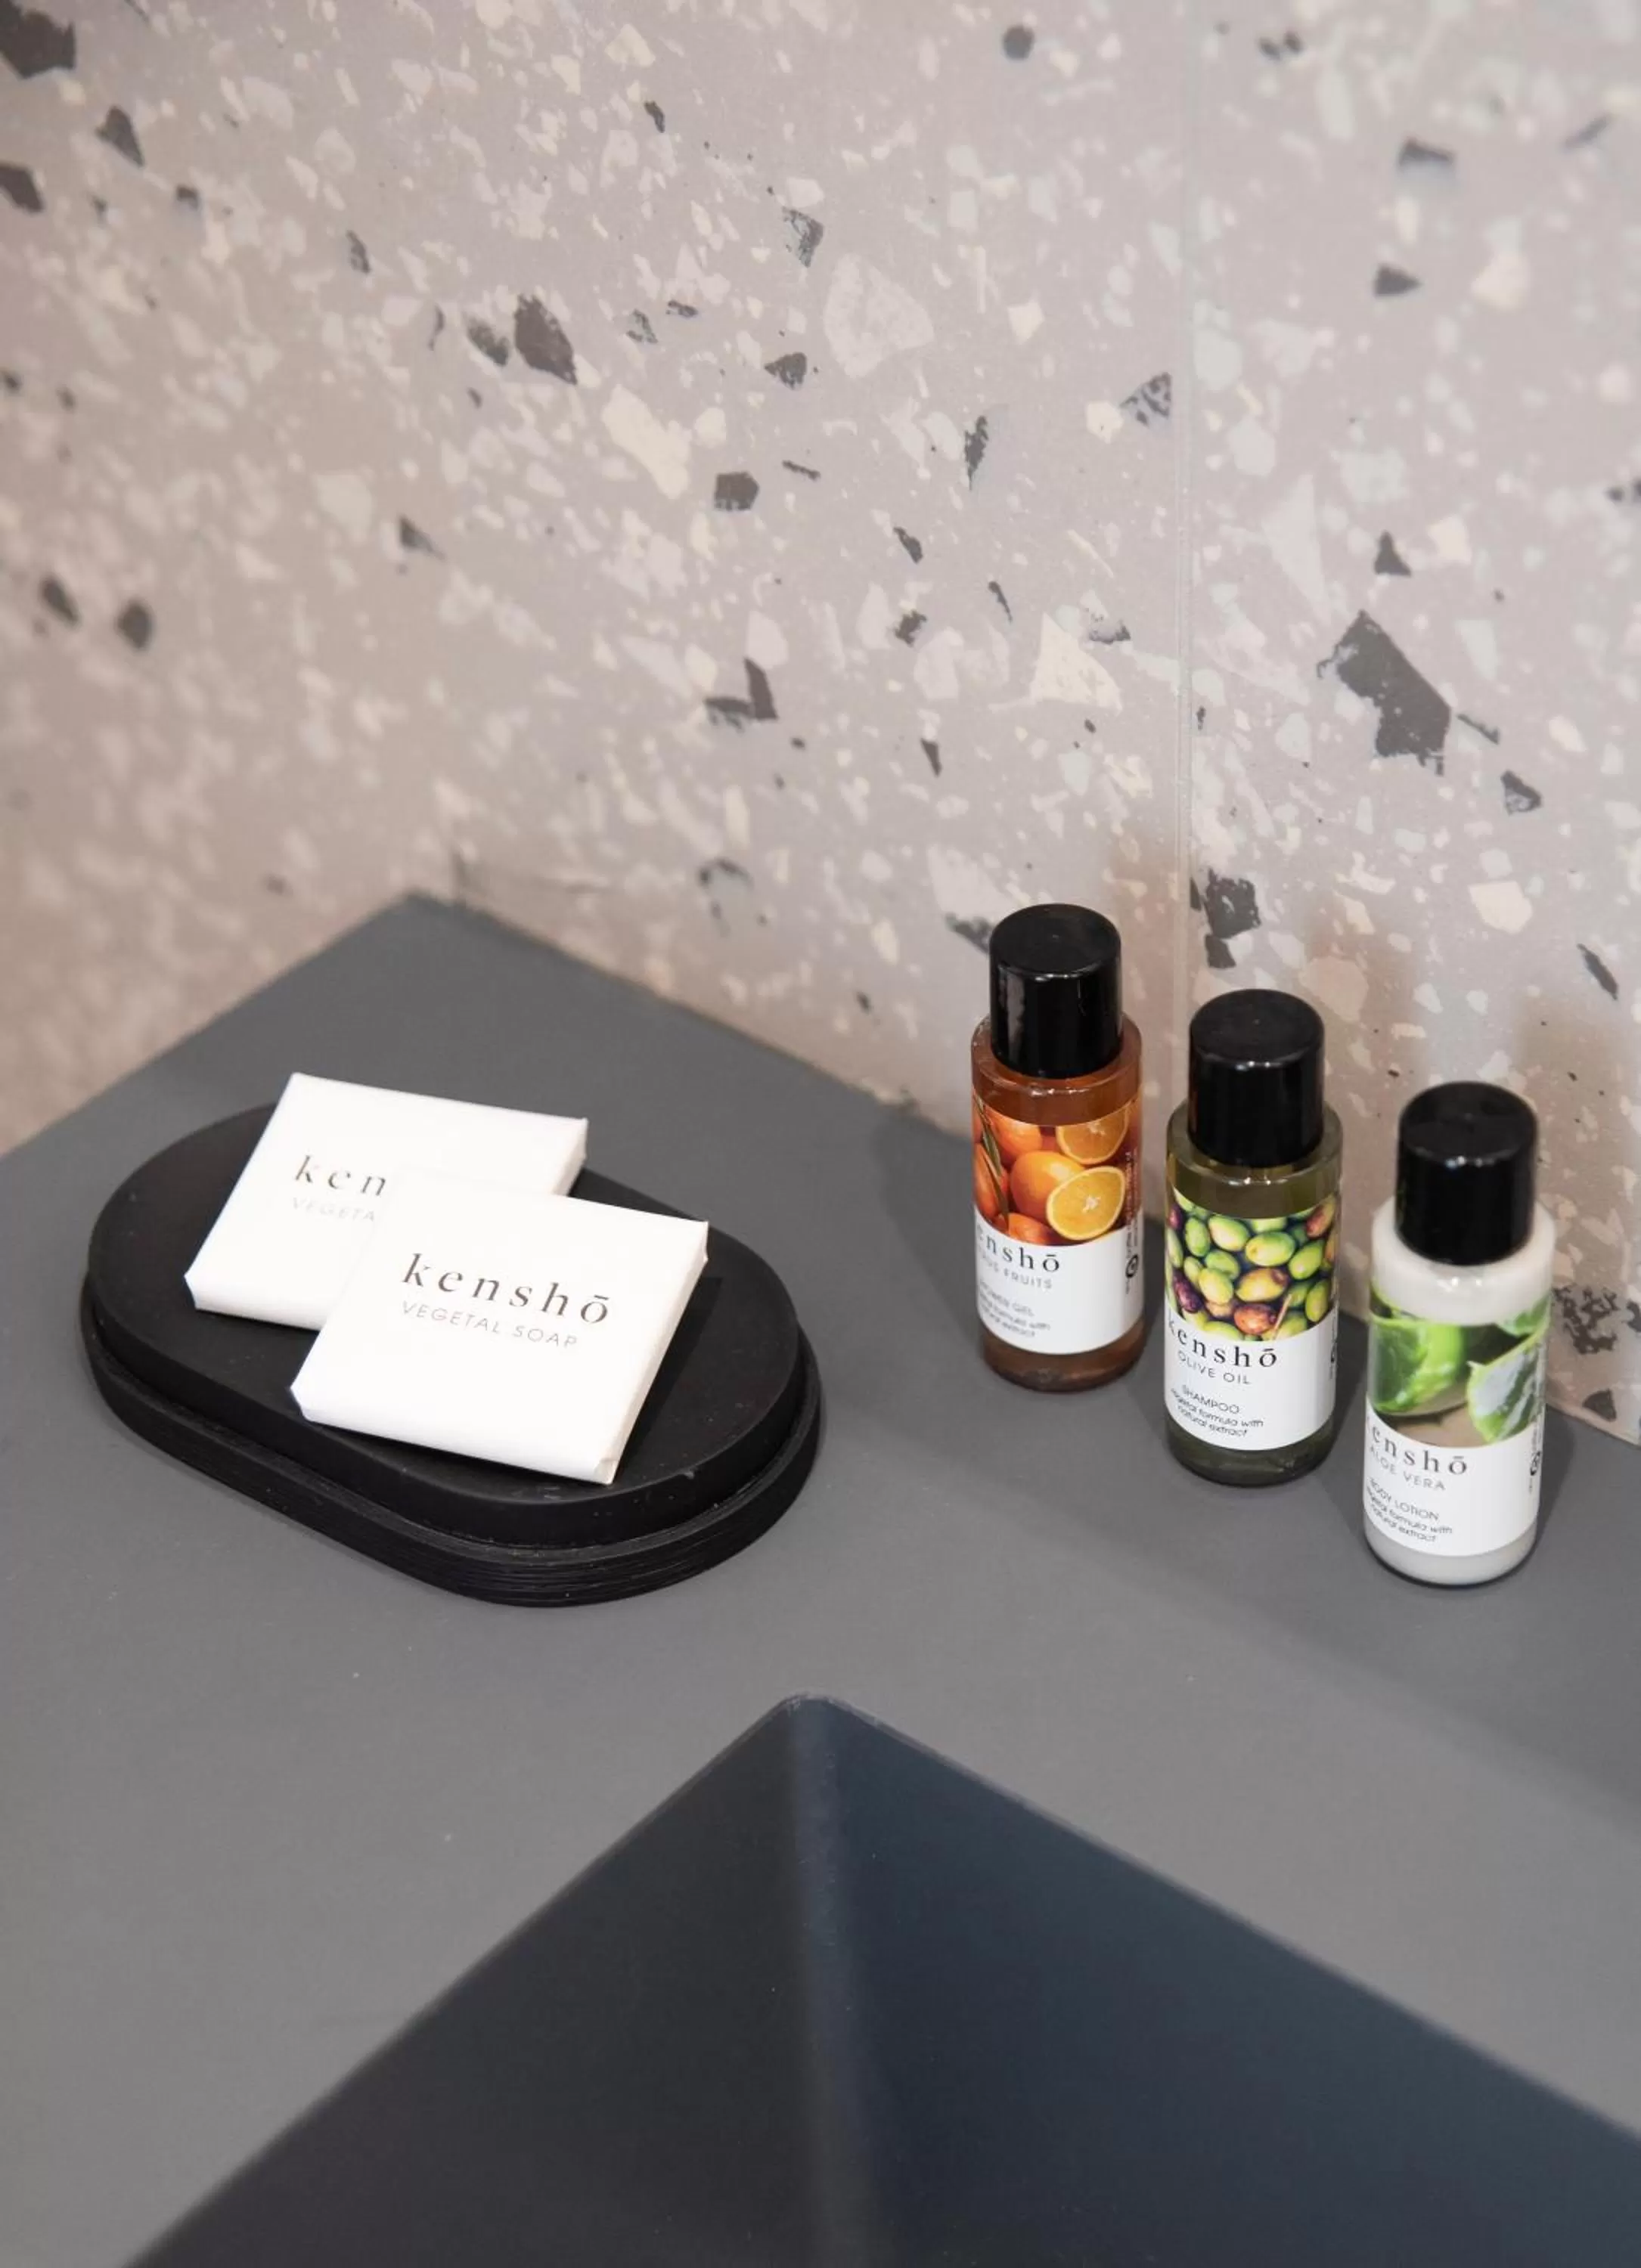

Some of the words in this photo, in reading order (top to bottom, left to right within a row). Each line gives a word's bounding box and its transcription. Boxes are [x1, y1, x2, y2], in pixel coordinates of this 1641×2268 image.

[293, 1154, 387, 1197] ken
[292, 1197, 376, 1222] VEGETA
[976, 1223, 1060, 1273] enshō
[402, 1252, 610, 1325] kenshō
[1004, 1268, 1053, 1289] FRUITS
[402, 1300, 501, 1334] VEGETAL
[512, 1324, 578, 1349] SOAP
[1177, 1349, 1216, 1378] OLIVE
[1222, 1371, 1252, 1385] OIL
[1182, 1384, 1240, 1414] SHAMPOO
[1242, 1419, 1264, 1428] with
[1370, 1445, 1398, 1475] ALOE
[1403, 1471, 1447, 1492] VERA
[1394, 1500, 1440, 1520] LOTION
